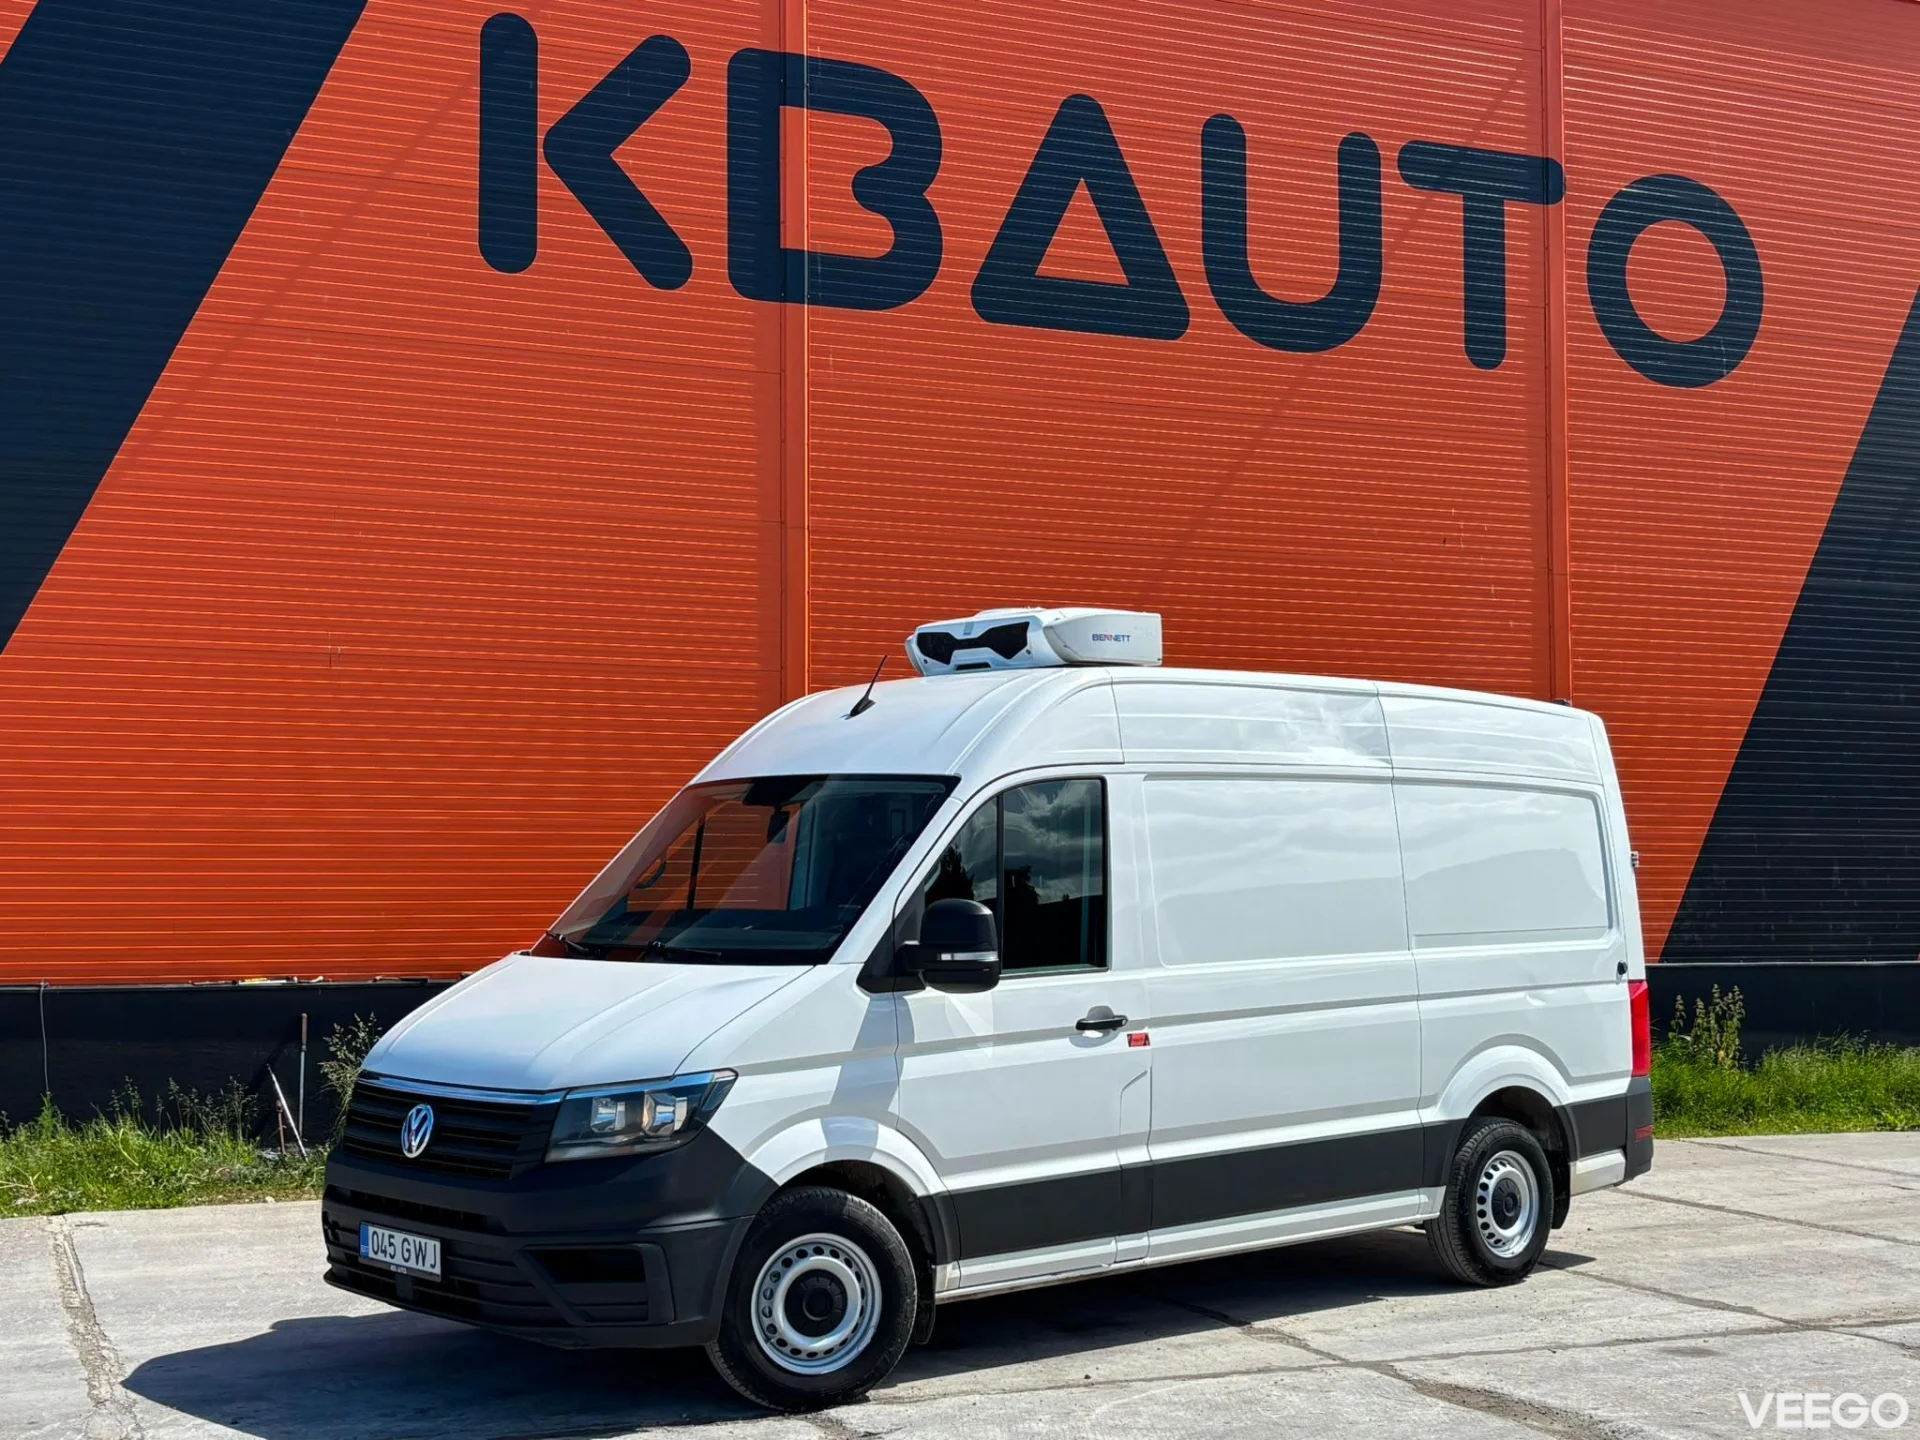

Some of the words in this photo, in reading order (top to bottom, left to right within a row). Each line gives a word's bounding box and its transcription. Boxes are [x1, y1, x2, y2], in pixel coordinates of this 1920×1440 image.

[478, 12, 1764, 388] KBAUTO
[1091, 633, 1131, 642] BENNETT
[371, 1230, 397, 1260] 045
[401, 1237, 437, 1269] GWJ
